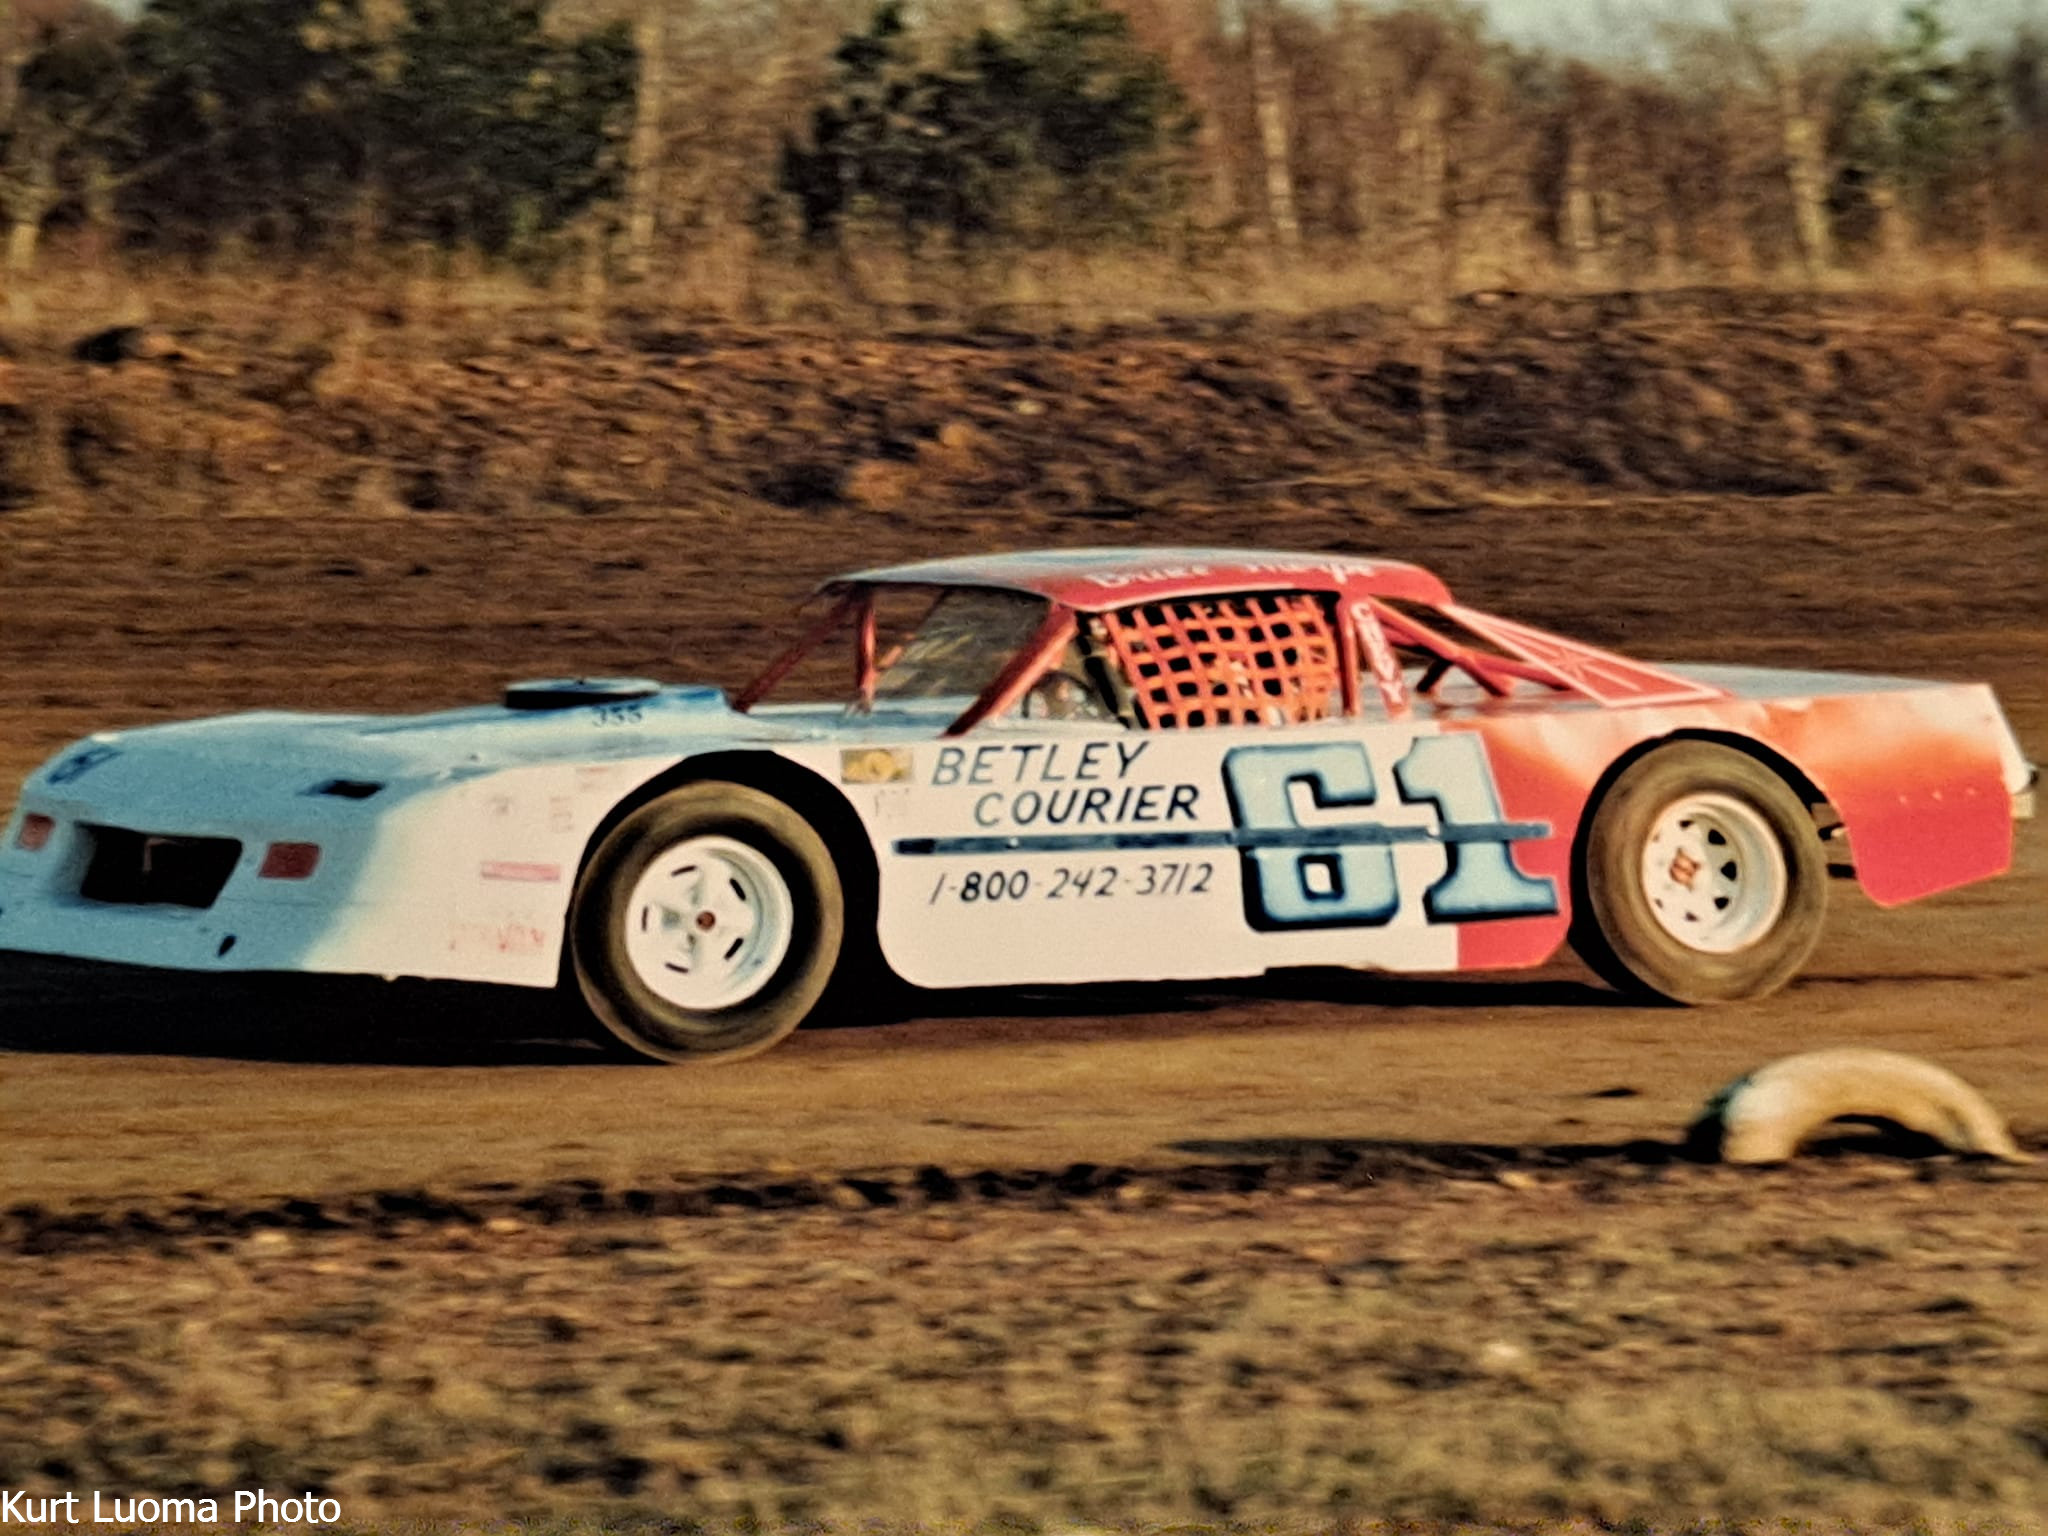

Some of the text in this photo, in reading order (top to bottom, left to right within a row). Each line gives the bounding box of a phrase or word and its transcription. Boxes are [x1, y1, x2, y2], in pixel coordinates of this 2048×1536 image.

[931, 741, 1150, 786] BETLEY
[973, 784, 1200, 828] COURIER
[1221, 731, 1560, 934] 61
[928, 862, 1214, 906] 1-800-242-3712
